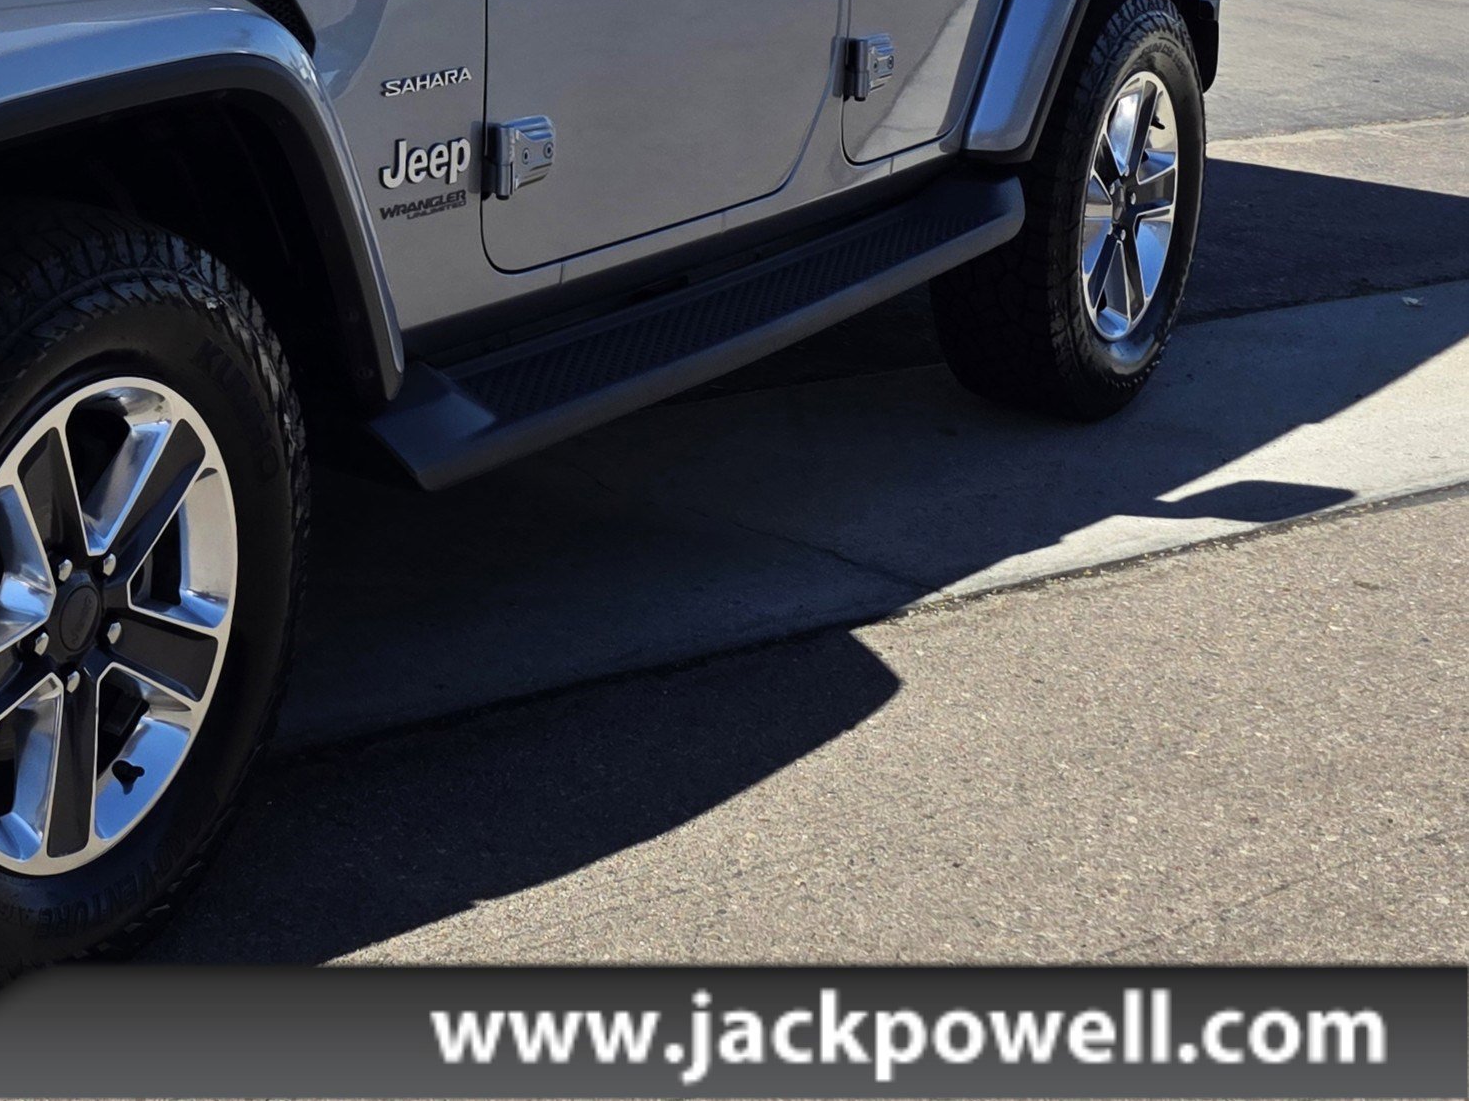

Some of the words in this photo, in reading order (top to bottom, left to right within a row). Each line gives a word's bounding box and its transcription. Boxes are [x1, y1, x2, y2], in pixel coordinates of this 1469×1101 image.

[382, 67, 472, 97] SAHARA
[380, 137, 471, 189] Jeep
[380, 189, 467, 220] WRANGLER
[407, 201, 467, 220] UNLIMITED
